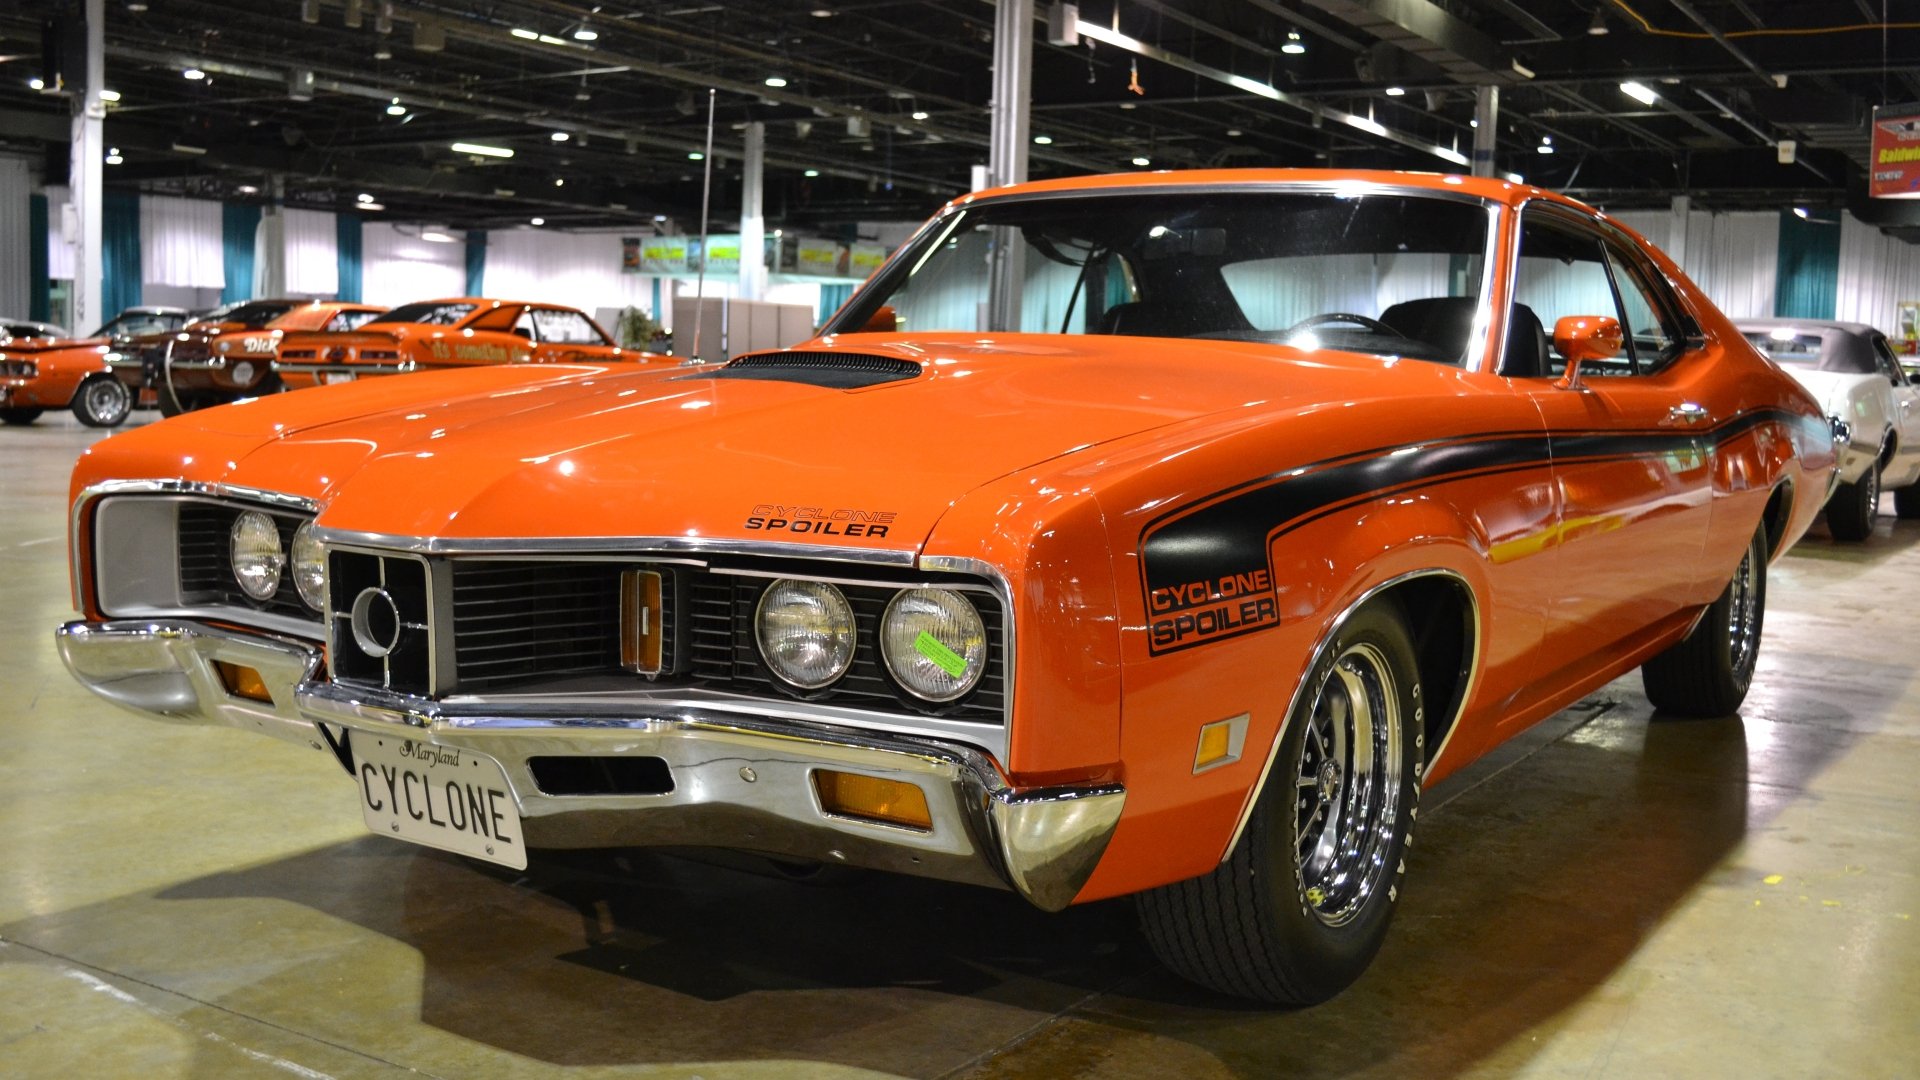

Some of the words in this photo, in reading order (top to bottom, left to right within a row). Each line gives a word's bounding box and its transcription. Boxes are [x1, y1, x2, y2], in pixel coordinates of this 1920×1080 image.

[1878, 145, 1920, 164] Baldwi
[744, 517, 890, 538] SPOILER
[751, 504, 898, 524] CYCLONE
[1151, 569, 1270, 611] CYCLONE
[1153, 597, 1276, 646] SPOILER
[399, 739, 461, 768] Maryland
[361, 763, 512, 844] CYCLONE
[1388, 683, 1423, 903] GOODYEAR
